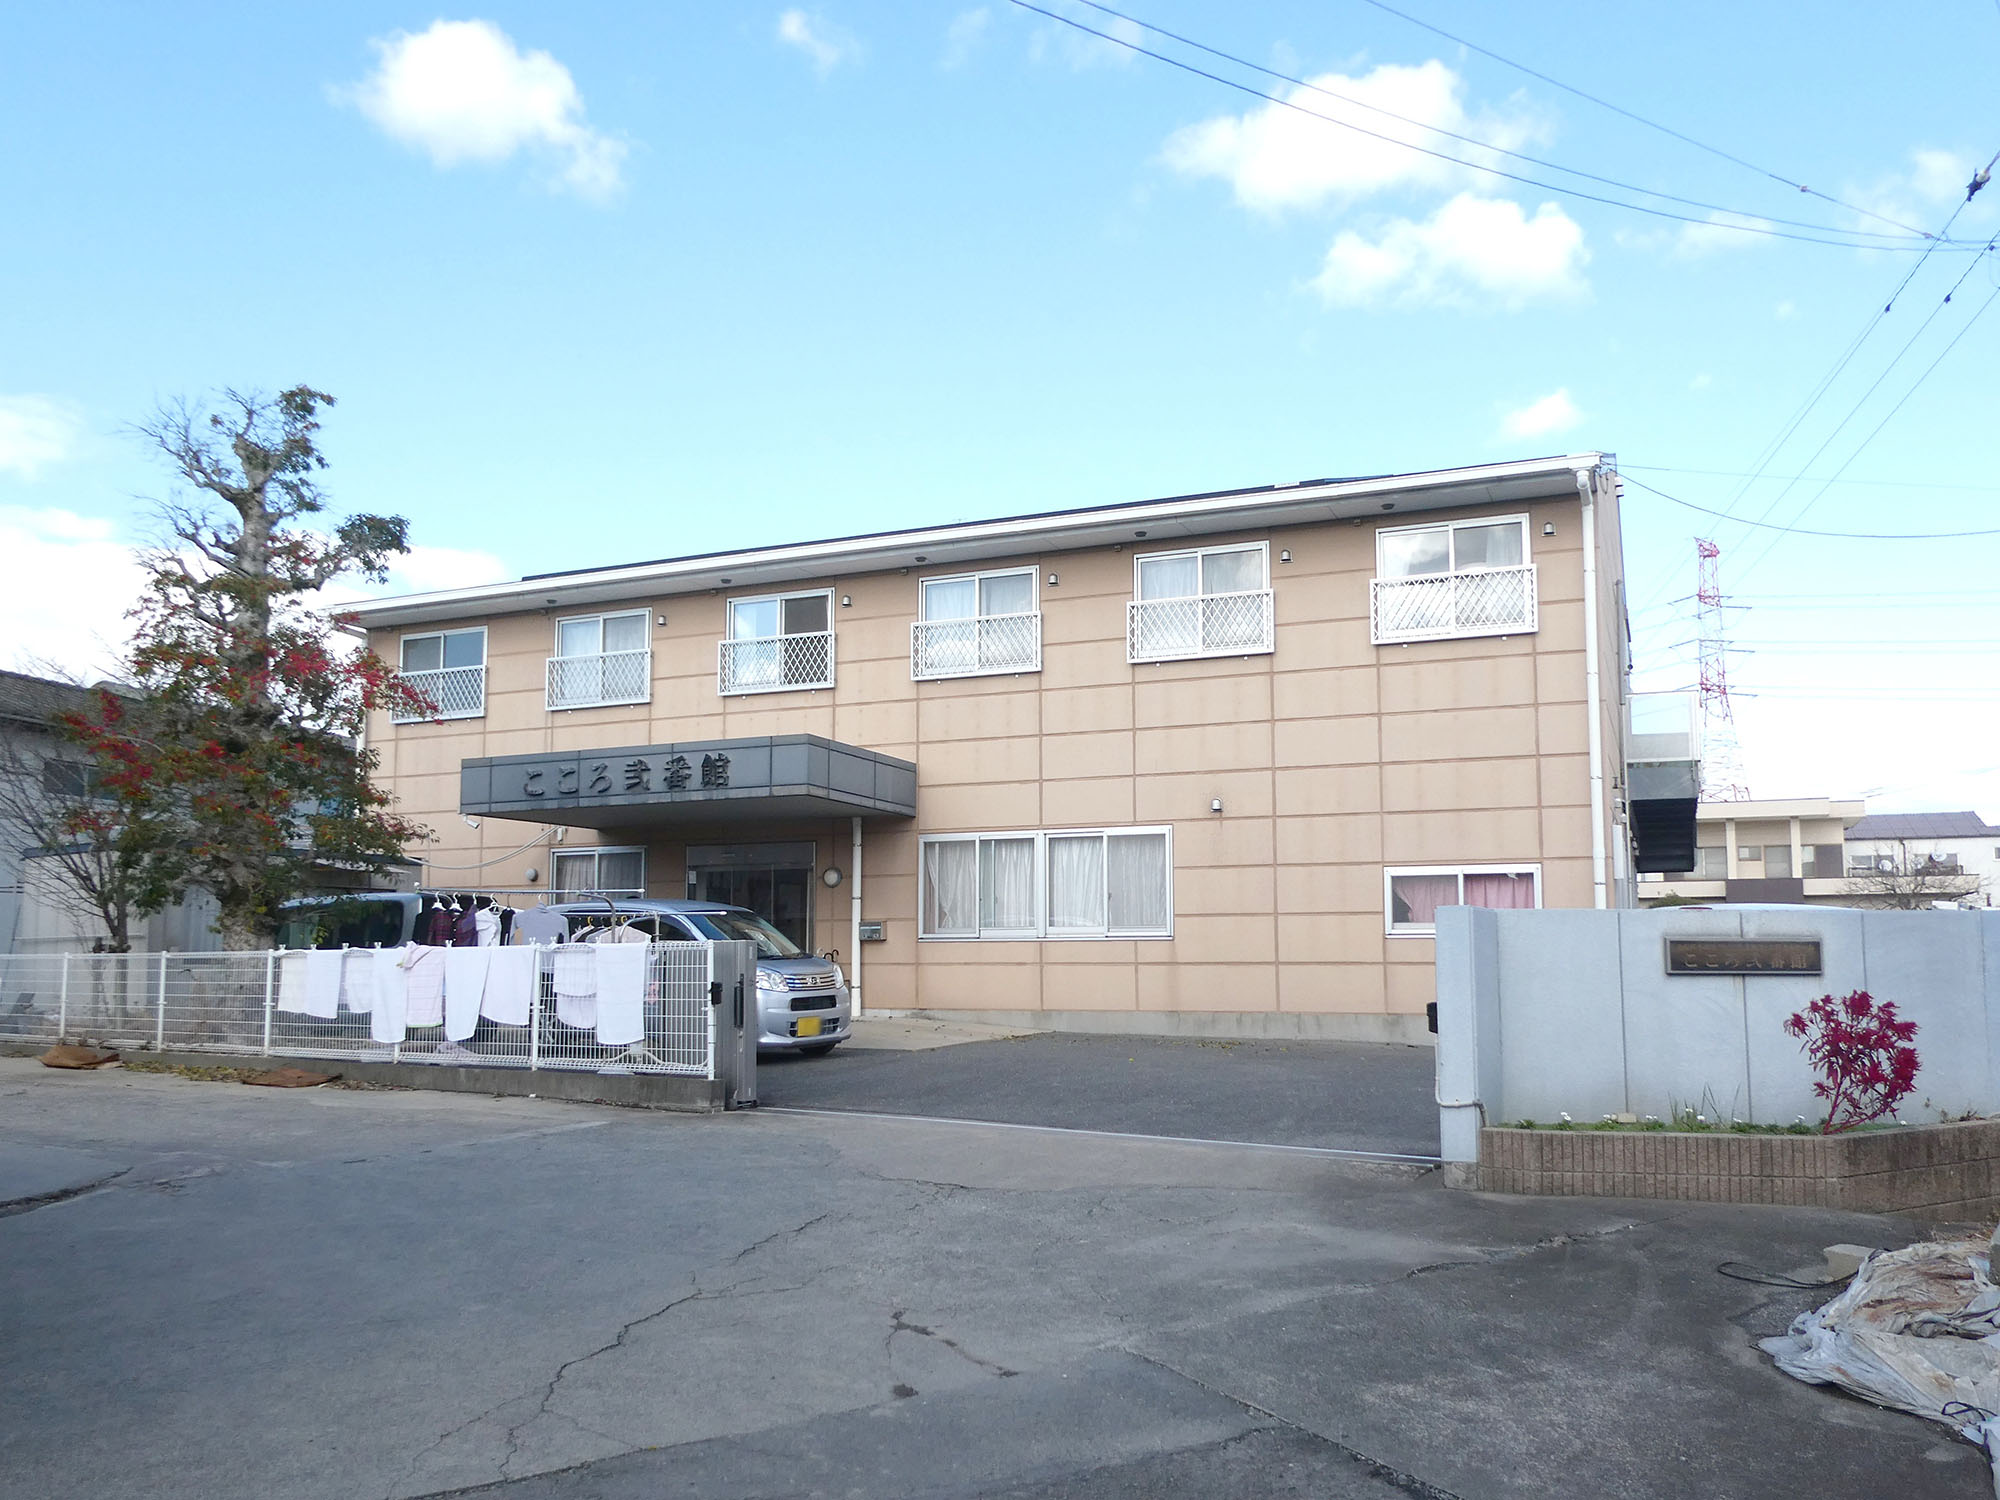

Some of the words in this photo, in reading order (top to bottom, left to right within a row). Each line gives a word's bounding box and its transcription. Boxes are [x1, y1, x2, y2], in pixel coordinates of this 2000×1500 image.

[523, 752, 731, 796] こころ弐番館
